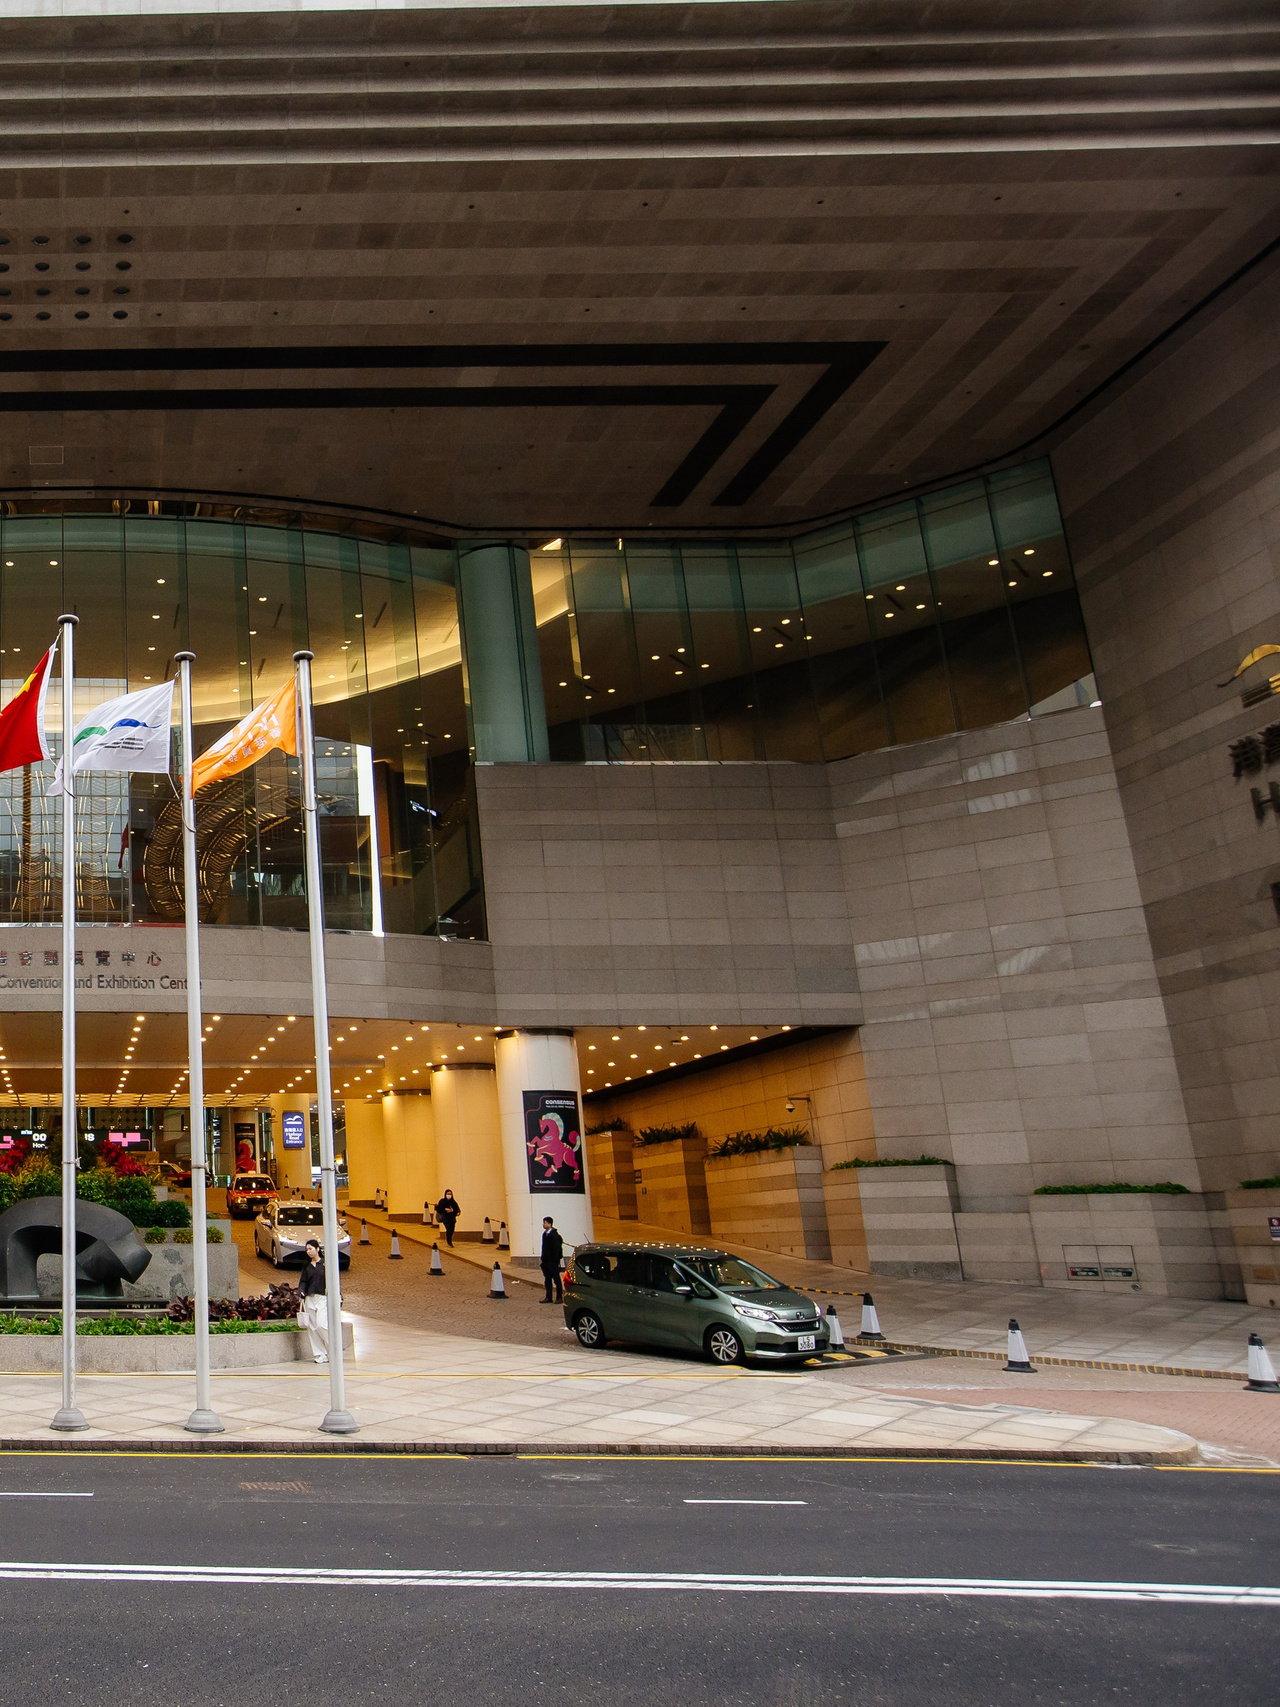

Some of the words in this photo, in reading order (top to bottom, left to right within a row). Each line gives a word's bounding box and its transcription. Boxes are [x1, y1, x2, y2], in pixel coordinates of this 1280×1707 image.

[74, 974, 93, 989] nd
[97, 974, 156, 990] Exhibition
[160, 975, 202, 990] Cent
